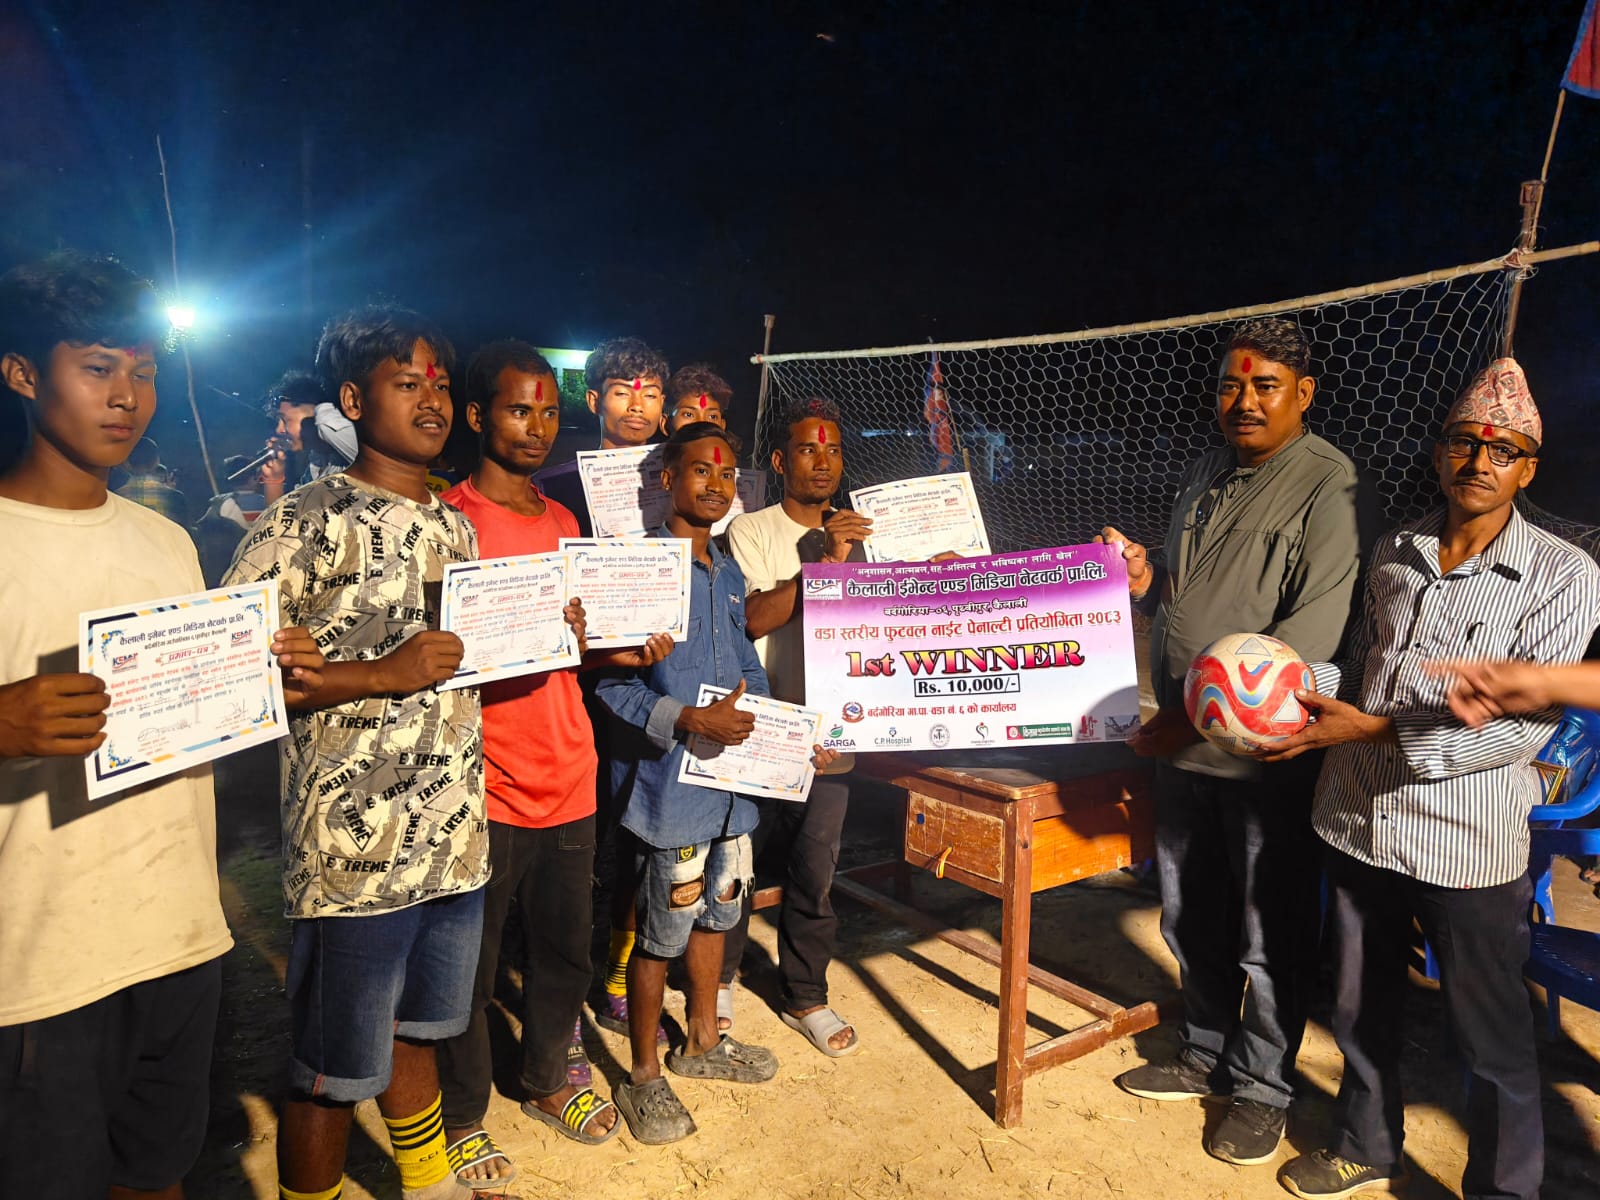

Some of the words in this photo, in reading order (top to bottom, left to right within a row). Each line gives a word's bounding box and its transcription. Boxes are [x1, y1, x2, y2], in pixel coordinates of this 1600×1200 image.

[370, 524, 385, 578] EXTREME
[397, 522, 424, 562] EXTREME
[847, 578, 895, 596] कैलाली
[940, 579, 967, 593] एण्ड
[971, 572, 1015, 591] मिडिया
[1020, 565, 1063, 586] नेटवर्क
[388, 605, 435, 624] EXTREME
[815, 627, 836, 640] वडा
[840, 623, 880, 641] स्तरीय
[931, 620, 963, 637] नाईट
[967, 616, 1012, 635] पेनाल्टी
[1017, 610, 1083, 632] प्रतियोगिता
[1087, 610, 1122, 624] २०८३
[845, 650, 896, 678] 1st
[900, 640, 1086, 677] WINNER
[918, 680, 942, 695] Rs.
[947, 677, 1017, 694] 10,000/-
[324, 714, 381, 730] EXTREME
[967, 703, 978, 714] को
[399, 752, 453, 768] EXTREME
[823, 739, 857, 748] SARGA
[318, 759, 372, 797] EXTREME
[366, 774, 418, 810] EXTREME
[405, 772, 454, 813] EXTREME
[338, 791, 372, 843] EXTREME
[427, 802, 471, 849] EXTREME
[396, 811, 421, 866] EXTREME
[325, 856, 390, 873] EXTREME
